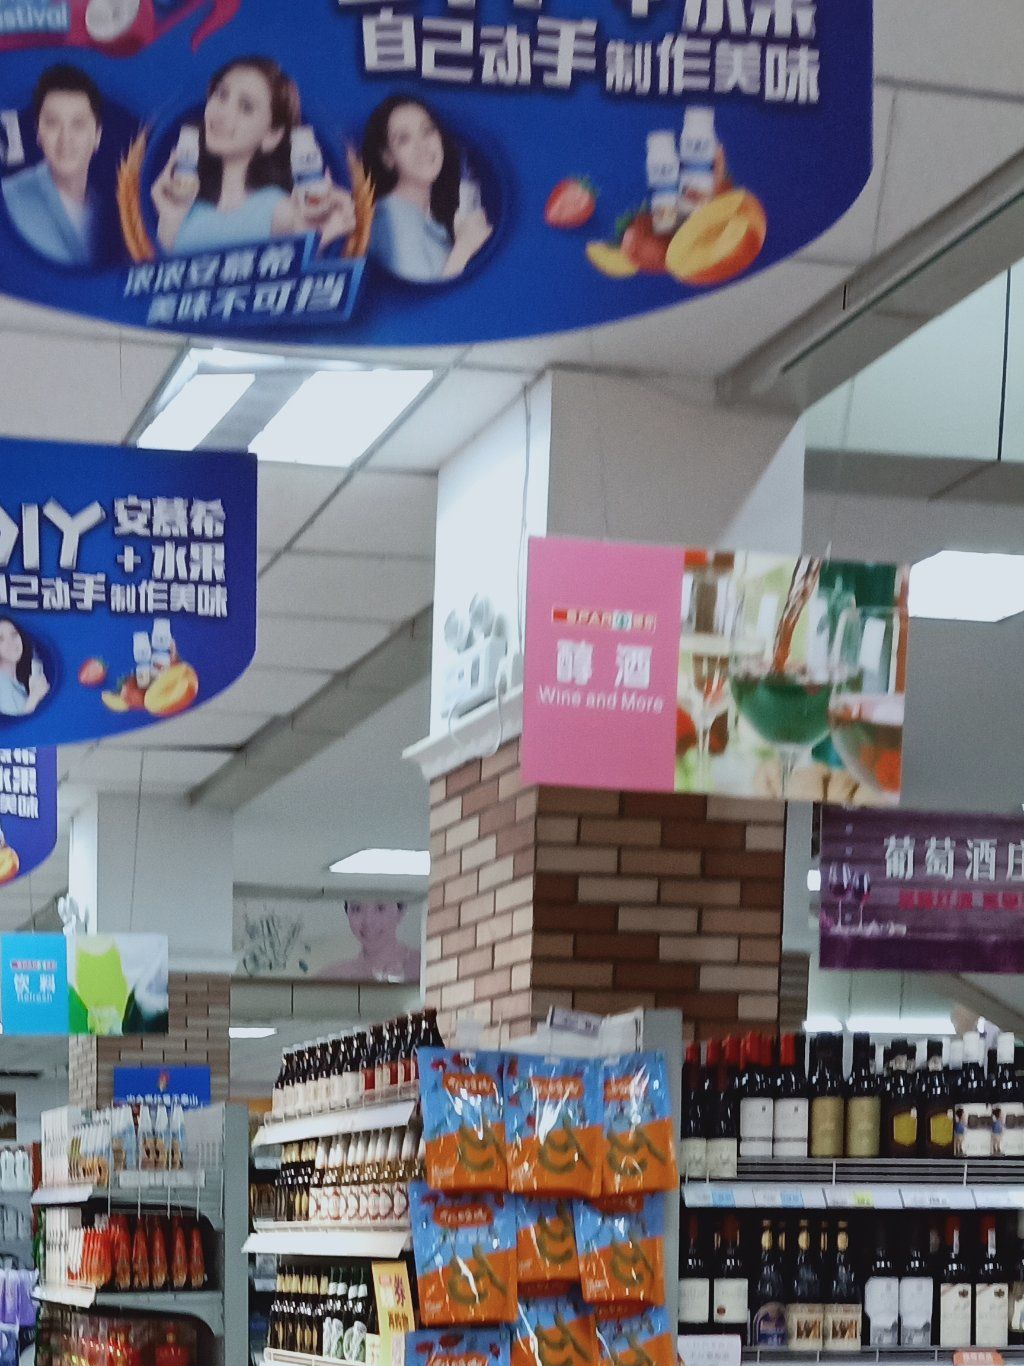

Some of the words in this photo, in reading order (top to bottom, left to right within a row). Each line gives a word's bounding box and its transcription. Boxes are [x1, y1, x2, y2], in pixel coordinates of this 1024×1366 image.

[362, 7, 820, 104] 自己动手制作美味
[114, 495, 226, 538] 安慕希
[539, 683, 582, 707] Wine
[586, 690, 617, 711] and
[621, 692, 664, 714] More
